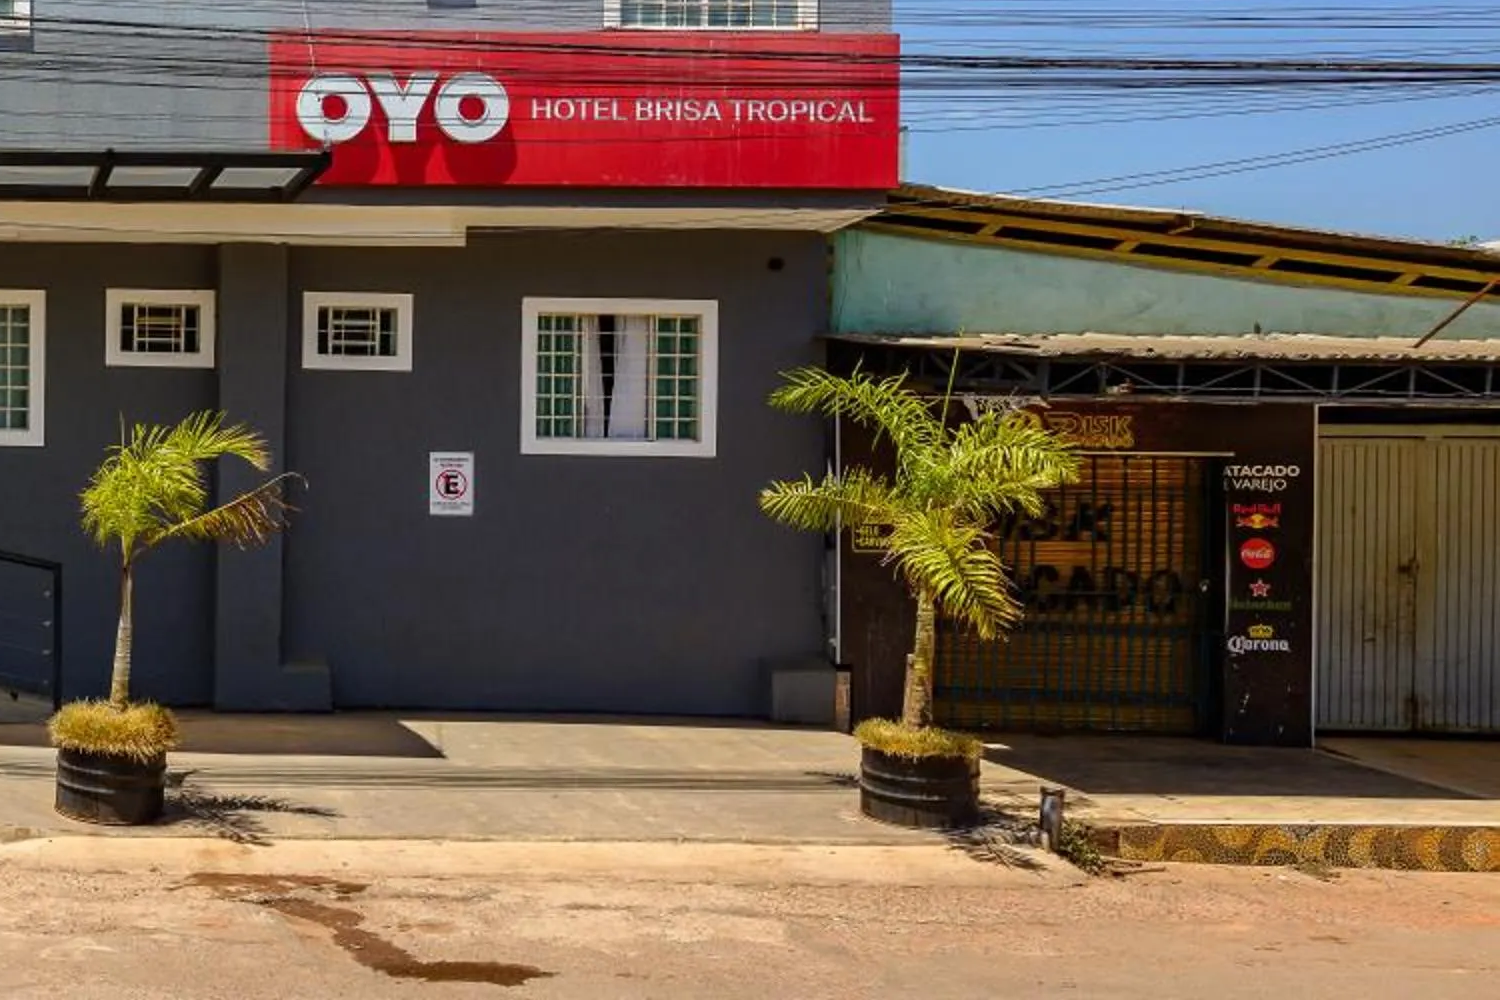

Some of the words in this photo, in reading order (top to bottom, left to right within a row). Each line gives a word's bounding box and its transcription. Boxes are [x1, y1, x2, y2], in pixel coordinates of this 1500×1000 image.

[296, 71, 510, 143] OYO
[531, 97, 627, 120] HOTEL
[635, 98, 722, 121] BRISA
[733, 98, 874, 123] TROPICAL
[1223, 465, 1300, 477] ATACADO
[1232, 479, 1287, 493] VAREJO
[1227, 635, 1291, 655] Corona
